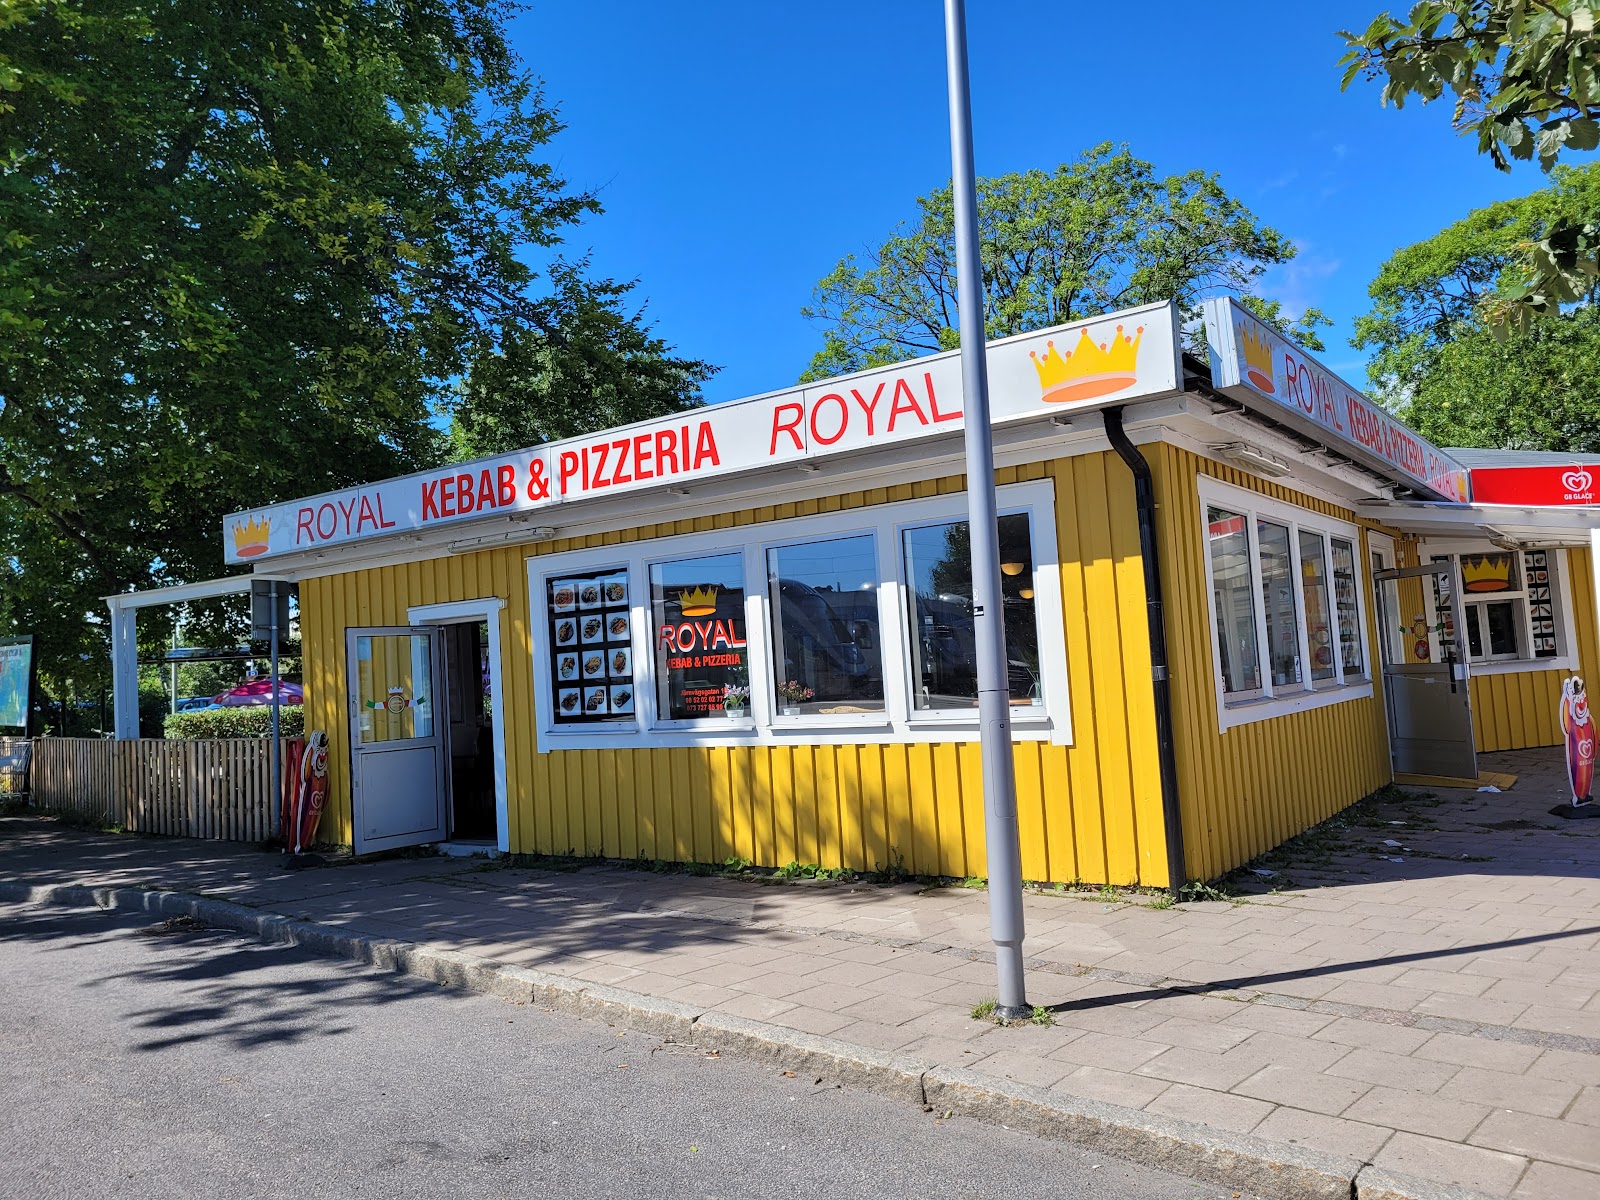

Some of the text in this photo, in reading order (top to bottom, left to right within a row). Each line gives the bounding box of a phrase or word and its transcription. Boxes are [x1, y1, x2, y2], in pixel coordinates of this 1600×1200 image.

[296, 372, 963, 545] ROYAL KEBAB & PIZZERIA ROYAL
[1285, 353, 1455, 497] ROYAL KEBAB & PIZZERIA ROYAL
[658, 619, 746, 653] ROYAL
[666, 653, 741, 669] KEBAB & PIZZERIA
